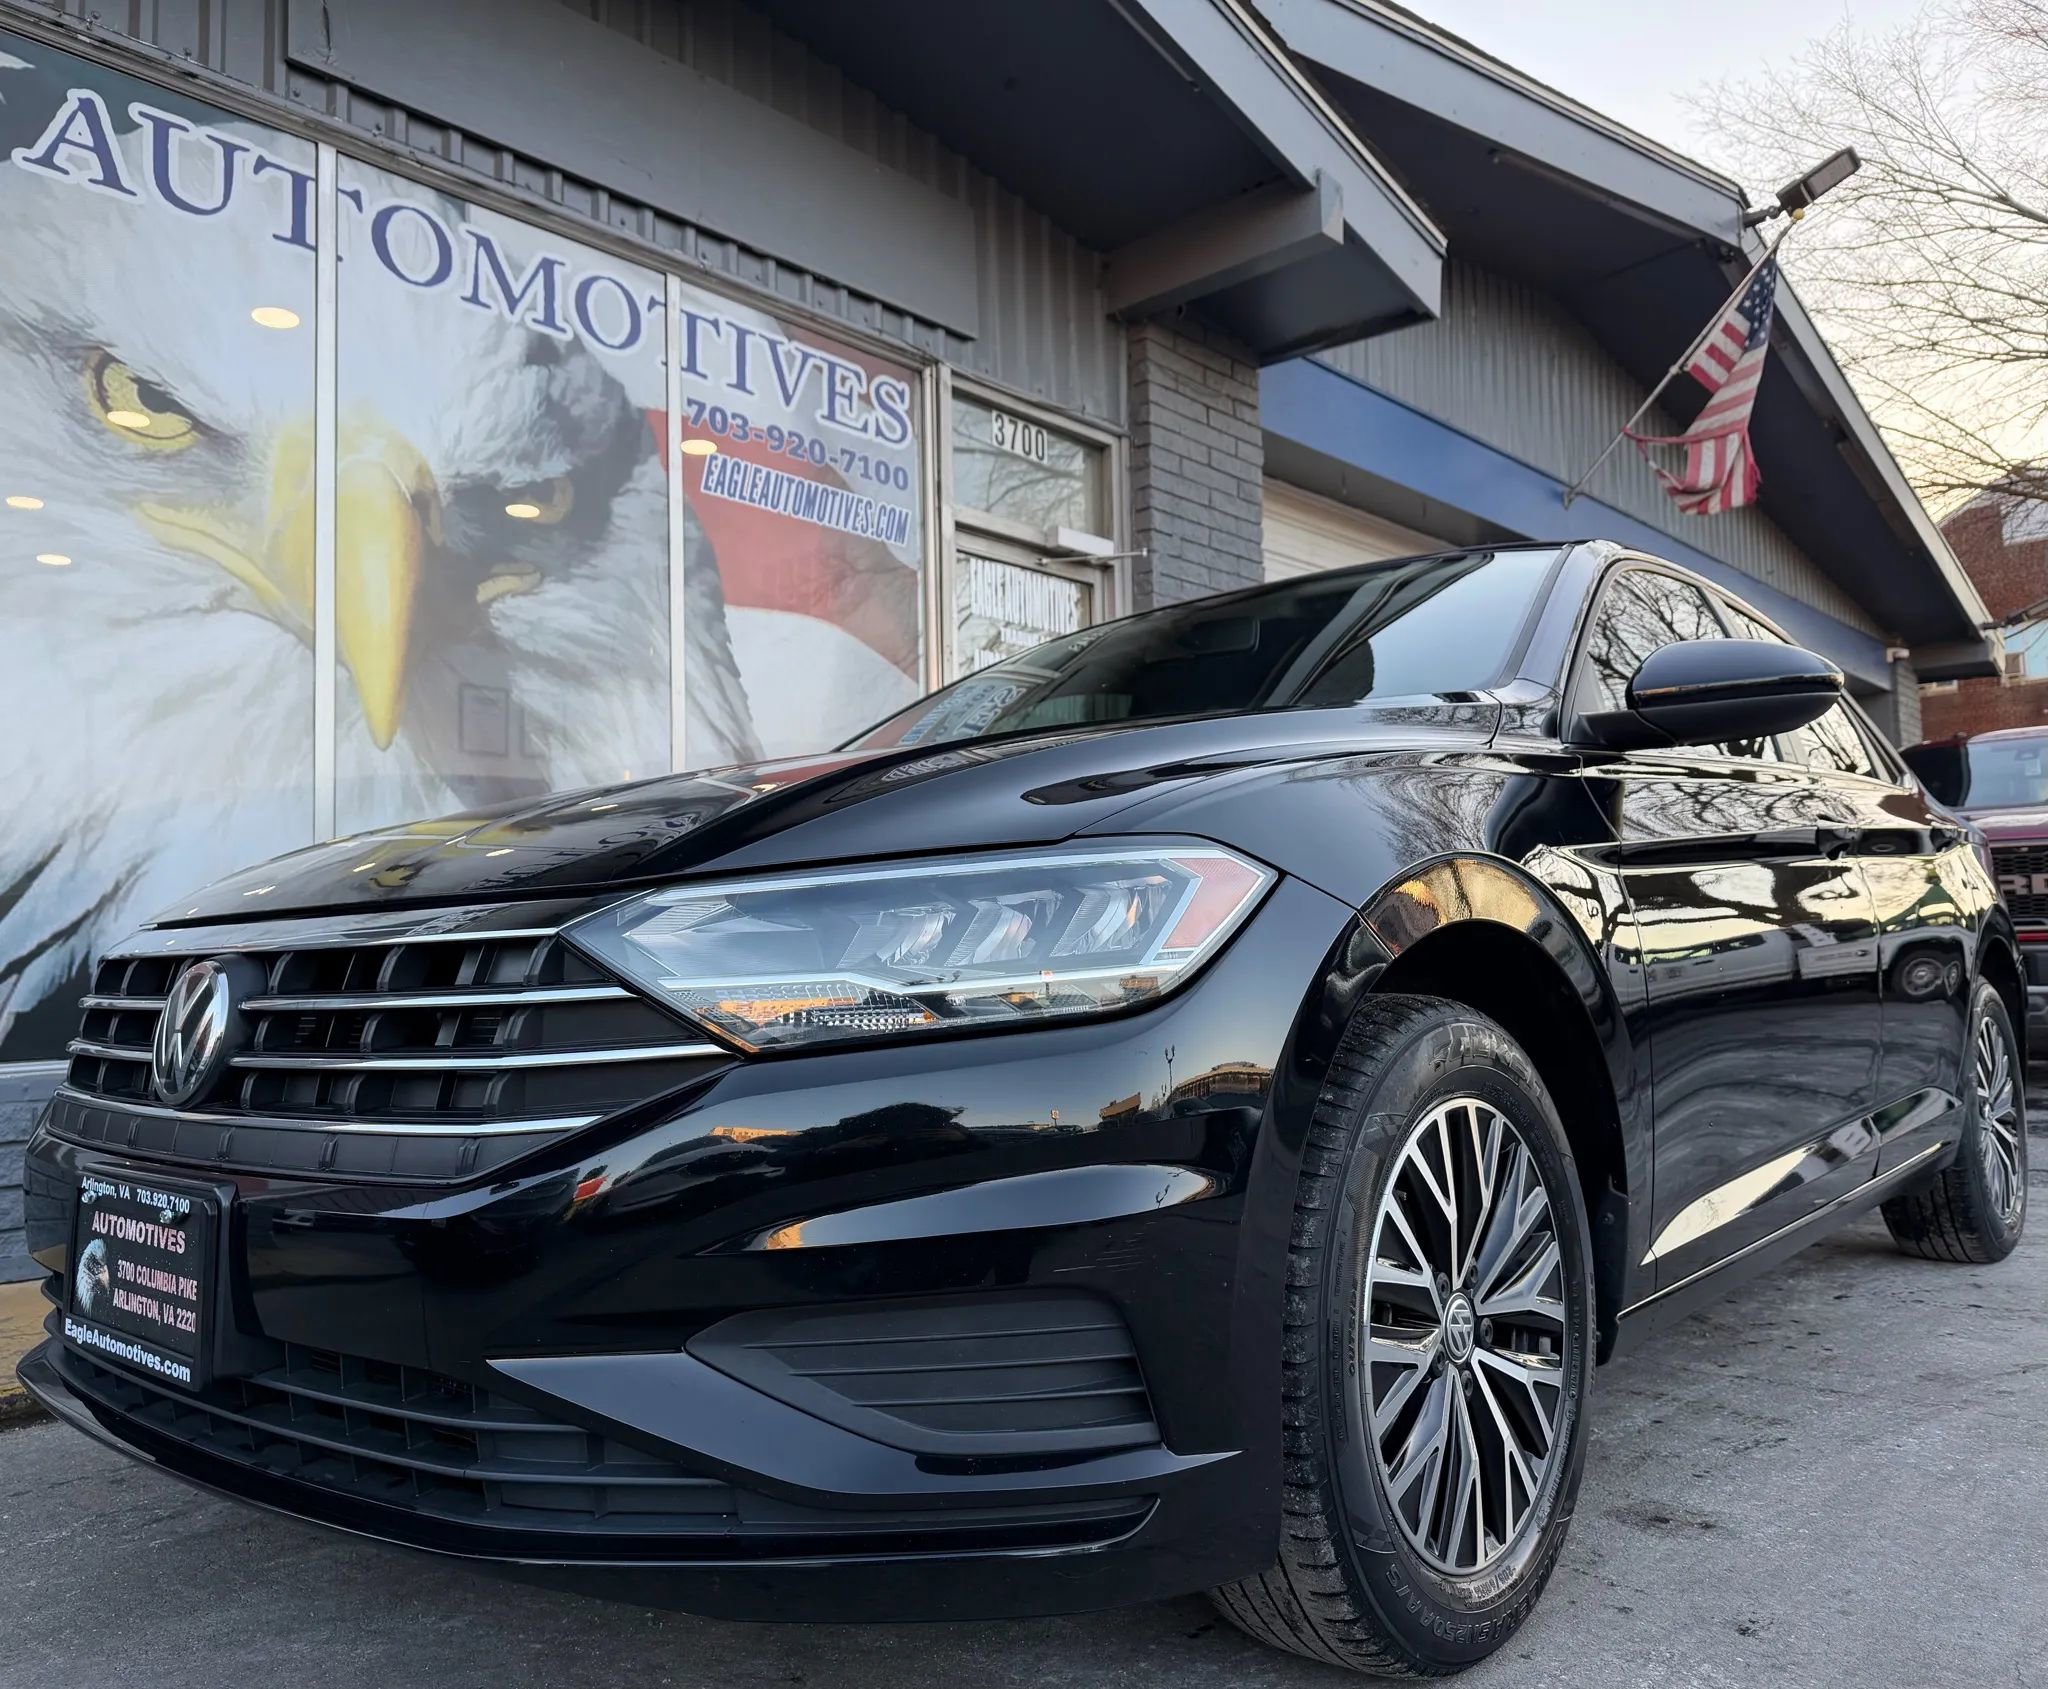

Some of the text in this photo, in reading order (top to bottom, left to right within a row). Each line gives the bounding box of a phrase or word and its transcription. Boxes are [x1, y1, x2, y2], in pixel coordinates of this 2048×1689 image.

[16, 93, 911, 445] AUTOMOTIVES
[687, 397, 909, 491] 703-920-7100
[994, 414, 1046, 461] 3700
[702, 457, 910, 546] EAGLEAUTOMOTIVES.COM
[81, 1176, 190, 1214] Arlington, VA 703.920.7100
[92, 1210, 186, 1254] AUTOMOTIVES
[117, 1259, 198, 1301] 3700 COLUMBIA PIKE
[113, 1288, 162, 1326] ARLINGTON,
[163, 1304, 175, 1326] VA
[65, 1317, 191, 1383] EagleAutomotives.com
